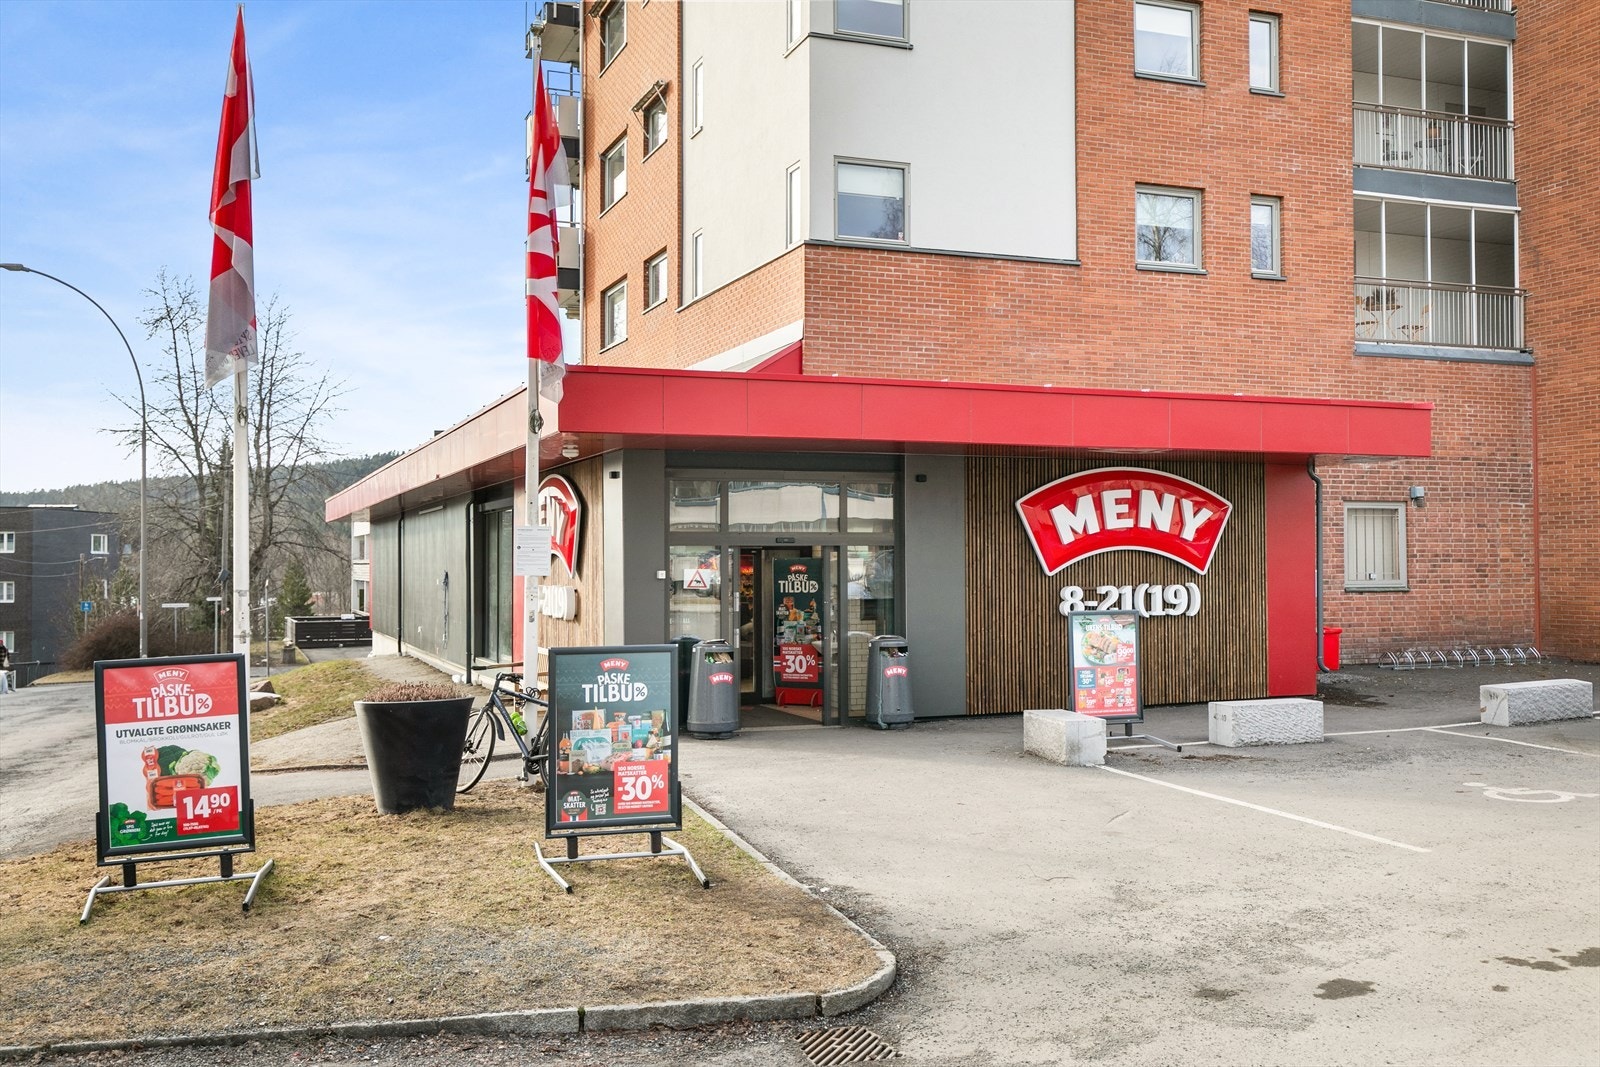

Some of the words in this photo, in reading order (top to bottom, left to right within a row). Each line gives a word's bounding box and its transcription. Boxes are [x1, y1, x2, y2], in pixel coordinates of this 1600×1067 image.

[1050, 488, 1213, 545] MENY
[787, 573, 809, 582] PÅSKE
[778, 580, 819, 593] TILBUD
[1059, 582, 1201, 618] 8-21(19)
[604, 660, 626, 669] MENY
[782, 654, 816, 674] -30%
[886, 667, 907, 675] MENY
[157, 670, 185, 680] MENY
[597, 672, 631, 685] PÅSKE
[712, 673, 733, 683] MENY
[151, 683, 195, 699] PÅSKE-
[582, 682, 648, 703] TILBUD
[132, 693, 213, 719] TILBUD
[116, 726, 164, 739] UTVALGTE
[166, 721, 231, 735] GRØNNSAKER
[617, 773, 665, 801] -30%
[563, 801, 586, 809] SKATTER
